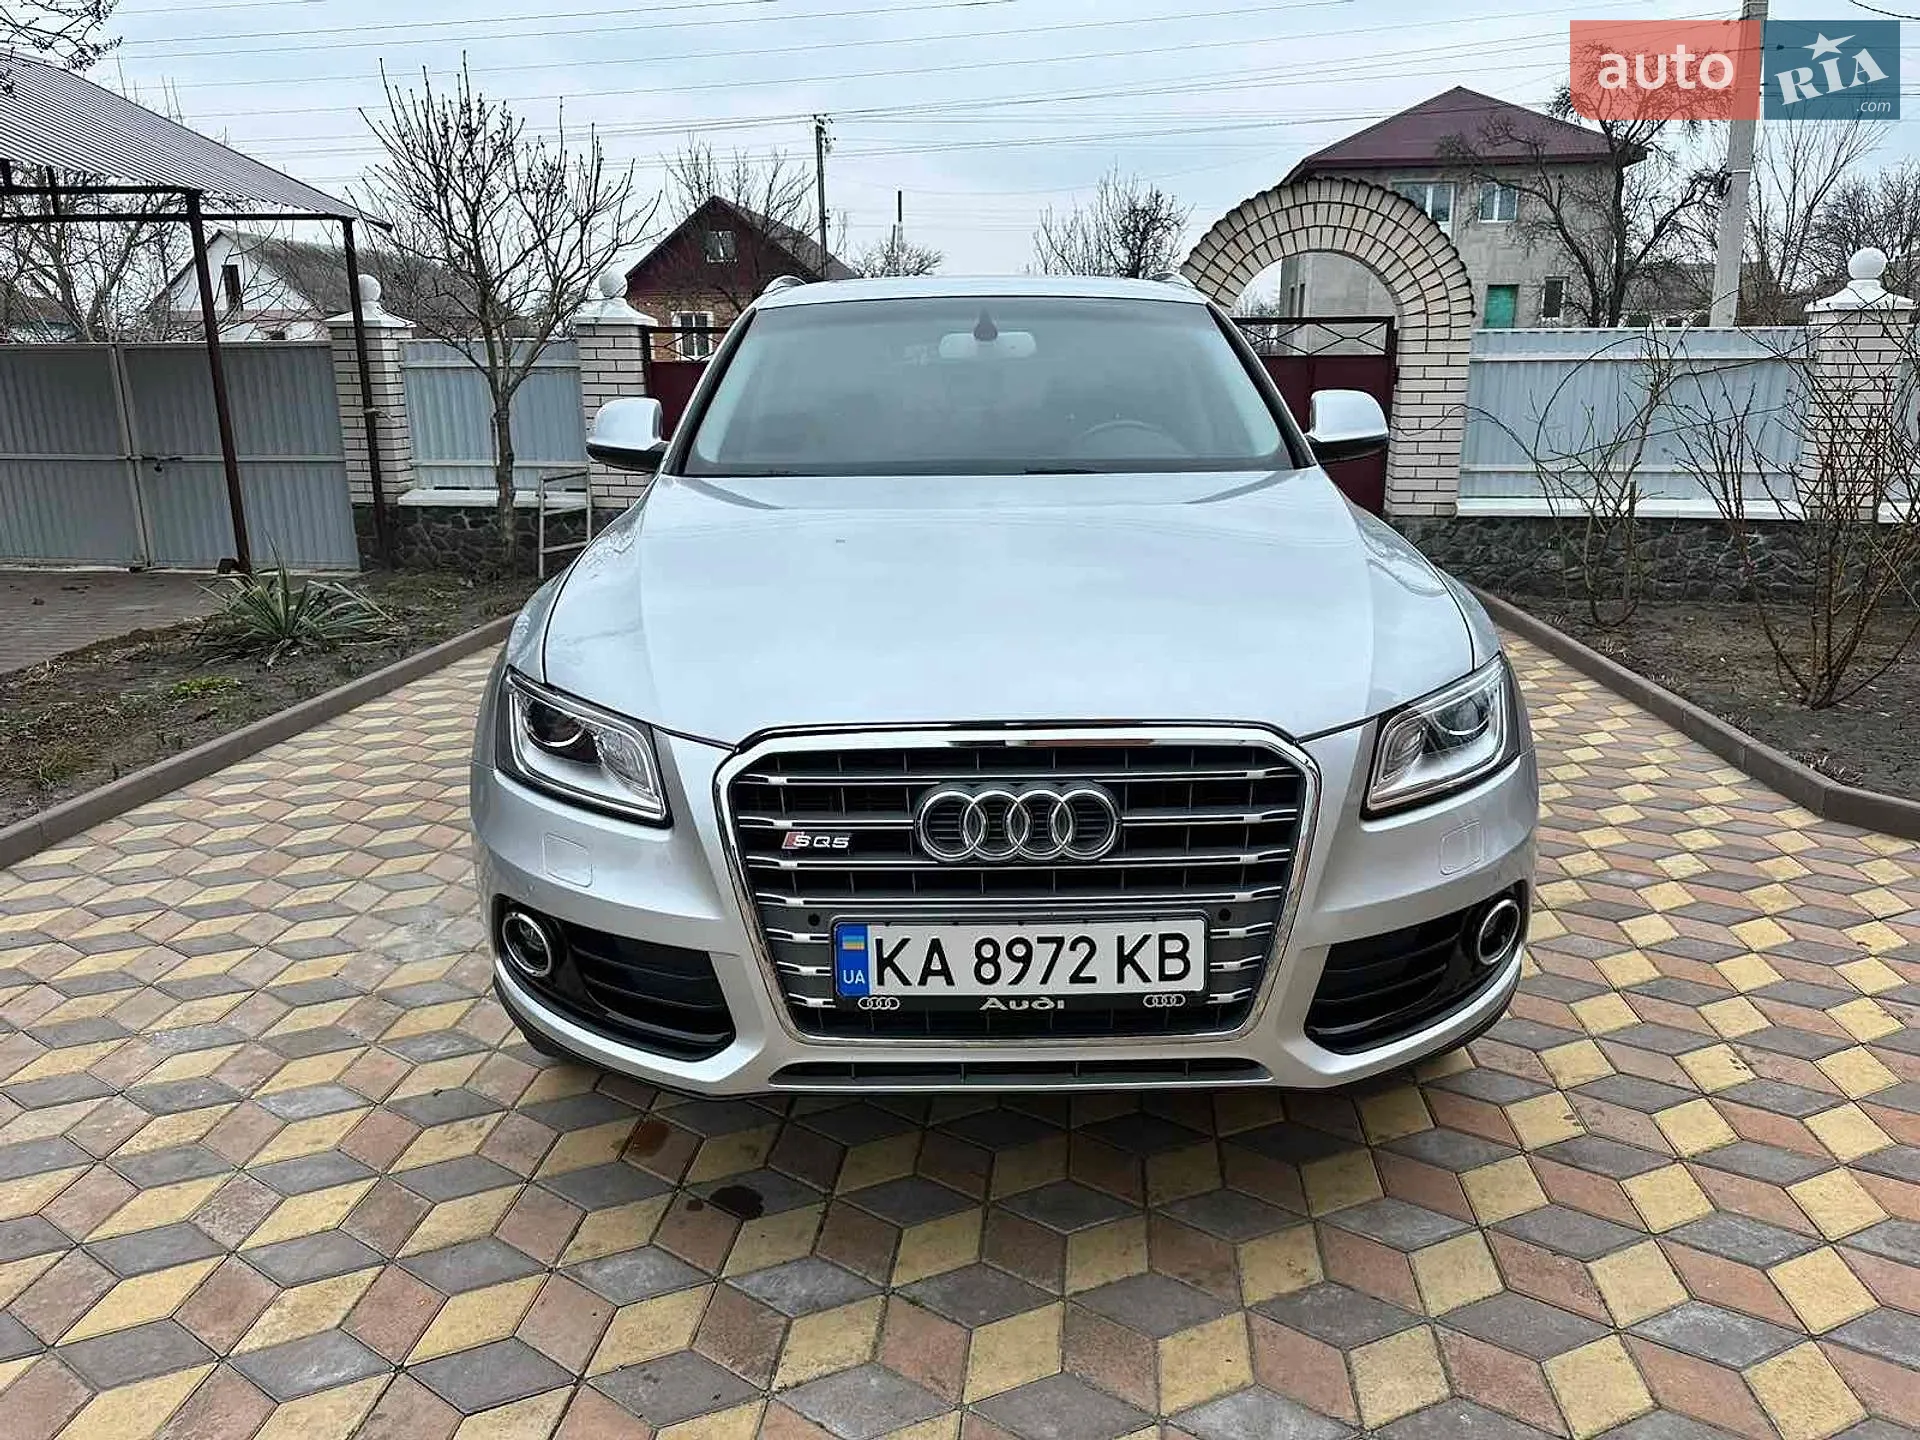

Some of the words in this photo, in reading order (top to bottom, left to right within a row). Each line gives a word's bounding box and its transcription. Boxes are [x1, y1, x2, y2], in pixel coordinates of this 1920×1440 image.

[789, 832, 850, 849] SQ5
[875, 936, 955, 987] KA
[974, 935, 1098, 986] 8972
[1115, 932, 1191, 984] KB
[843, 970, 865, 985] UA
[979, 996, 1065, 1011] Audi
